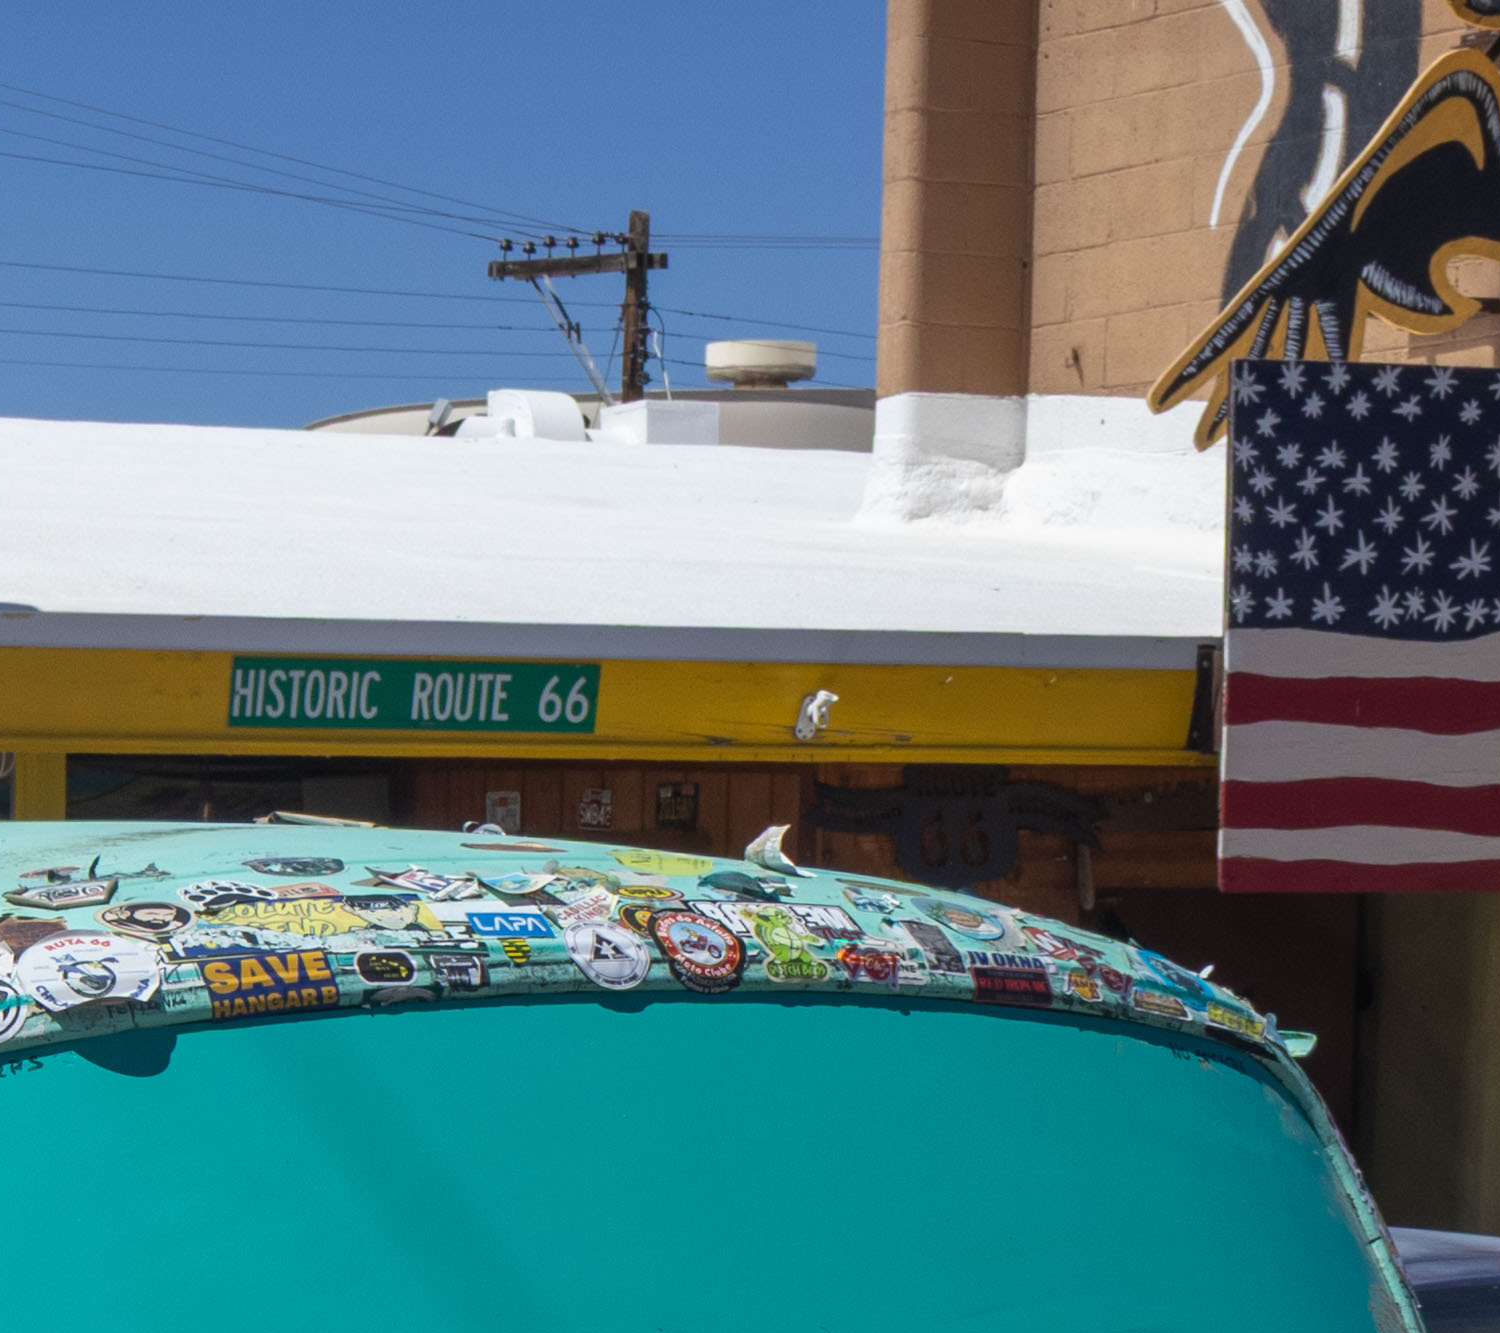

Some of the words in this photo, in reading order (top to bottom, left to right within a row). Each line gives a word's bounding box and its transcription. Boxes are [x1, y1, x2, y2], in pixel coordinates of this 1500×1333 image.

[231, 669, 381, 719] HISTORIC
[410, 672, 512, 722] ROUTE
[537, 675, 590, 723] 66
[471, 913, 549, 936] LAPA
[44, 937, 85, 953] RUTA
[86, 937, 112, 951] 66
[203, 951, 332, 994] SAVE
[213, 989, 313, 1020] HANGAR
[320, 986, 339, 1005] B
